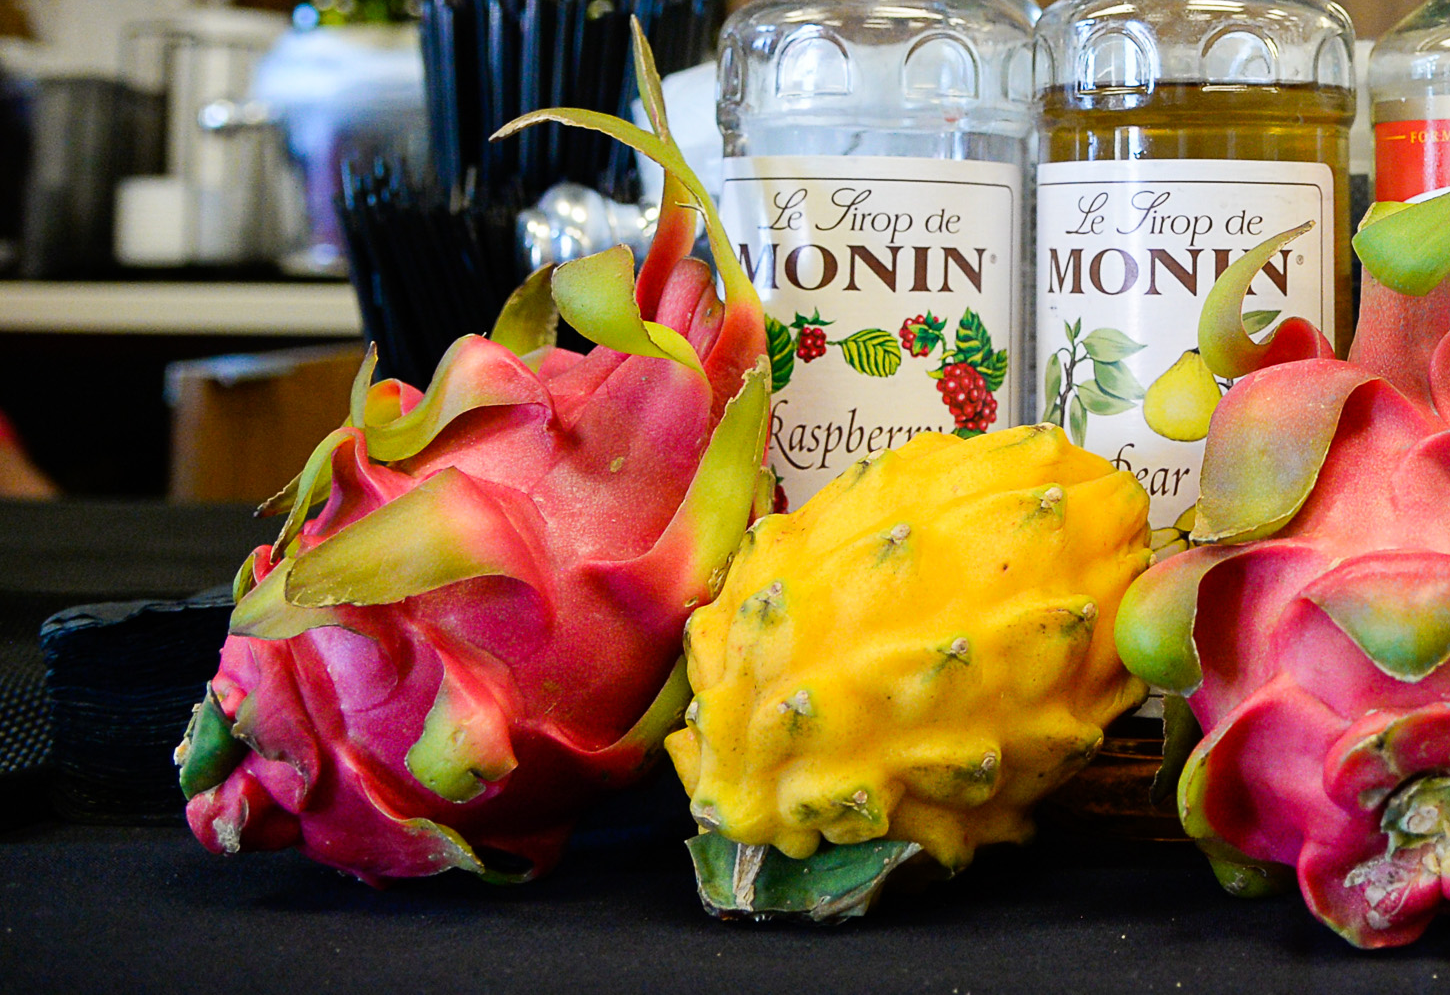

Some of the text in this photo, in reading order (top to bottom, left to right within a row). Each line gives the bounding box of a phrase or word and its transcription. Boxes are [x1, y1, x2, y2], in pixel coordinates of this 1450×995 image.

[757, 187, 961, 244] Le Sirop de
[1065, 190, 1263, 247] Le Sirop de
[738, 243, 987, 294] MONIN
[769, 399, 943, 471] Raspberr
